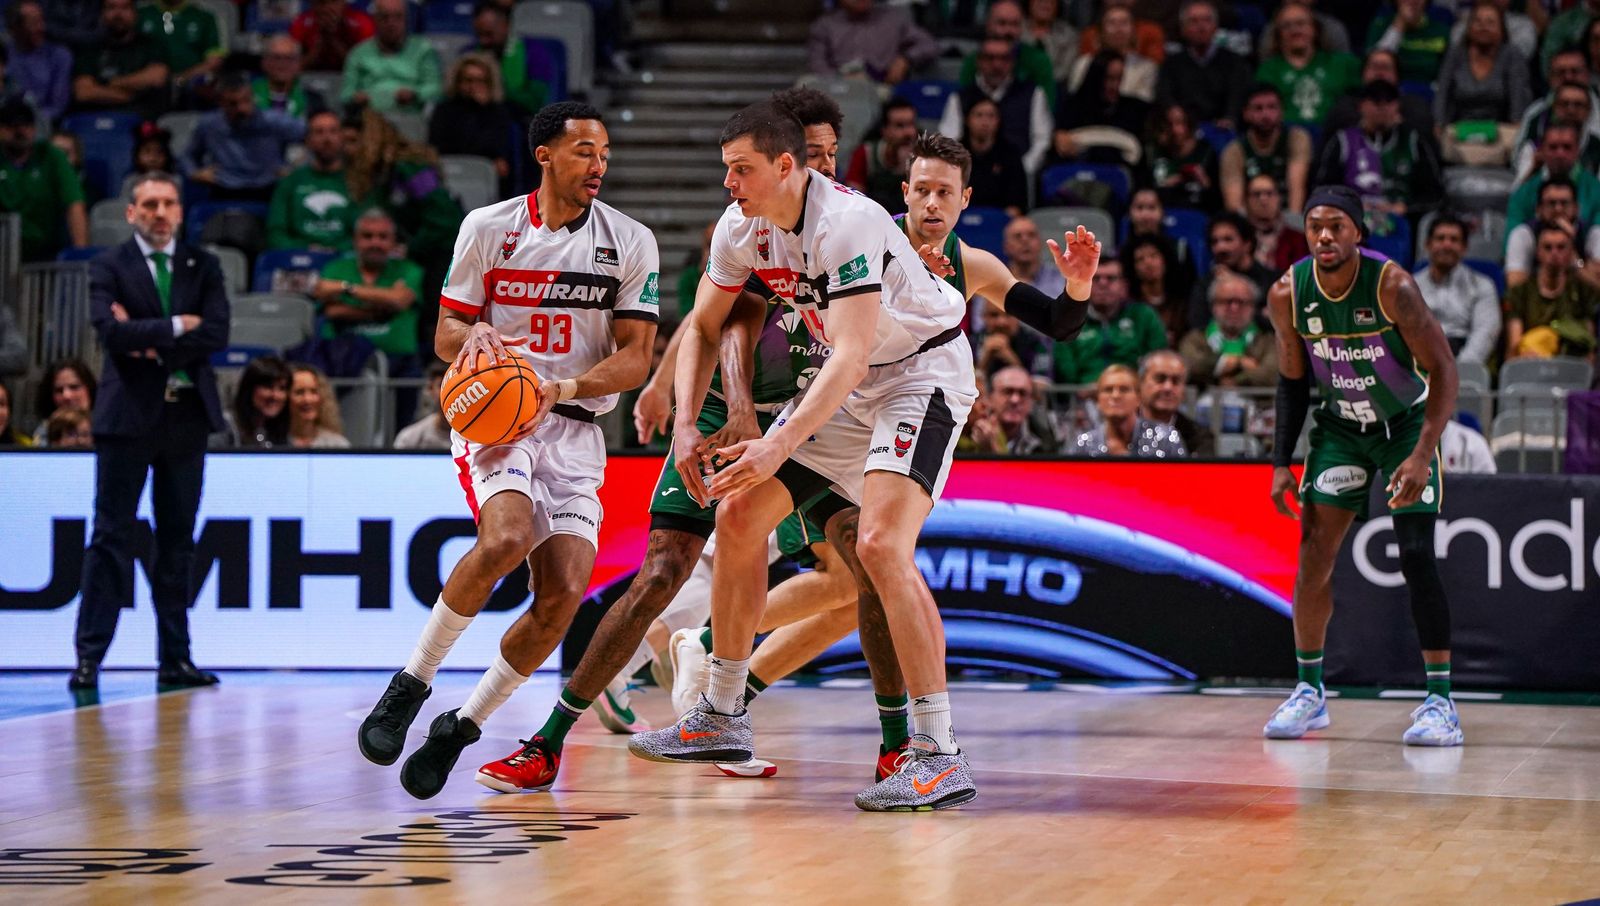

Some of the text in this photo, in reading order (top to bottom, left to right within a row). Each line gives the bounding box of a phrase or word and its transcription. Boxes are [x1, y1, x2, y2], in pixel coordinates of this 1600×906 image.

[529, 313, 572, 354] 93
[1329, 344, 1385, 363] Unicaja
[445, 381, 490, 422] Wilson
[551, 512, 596, 527] BERNER
[1352, 498, 1600, 592] end
